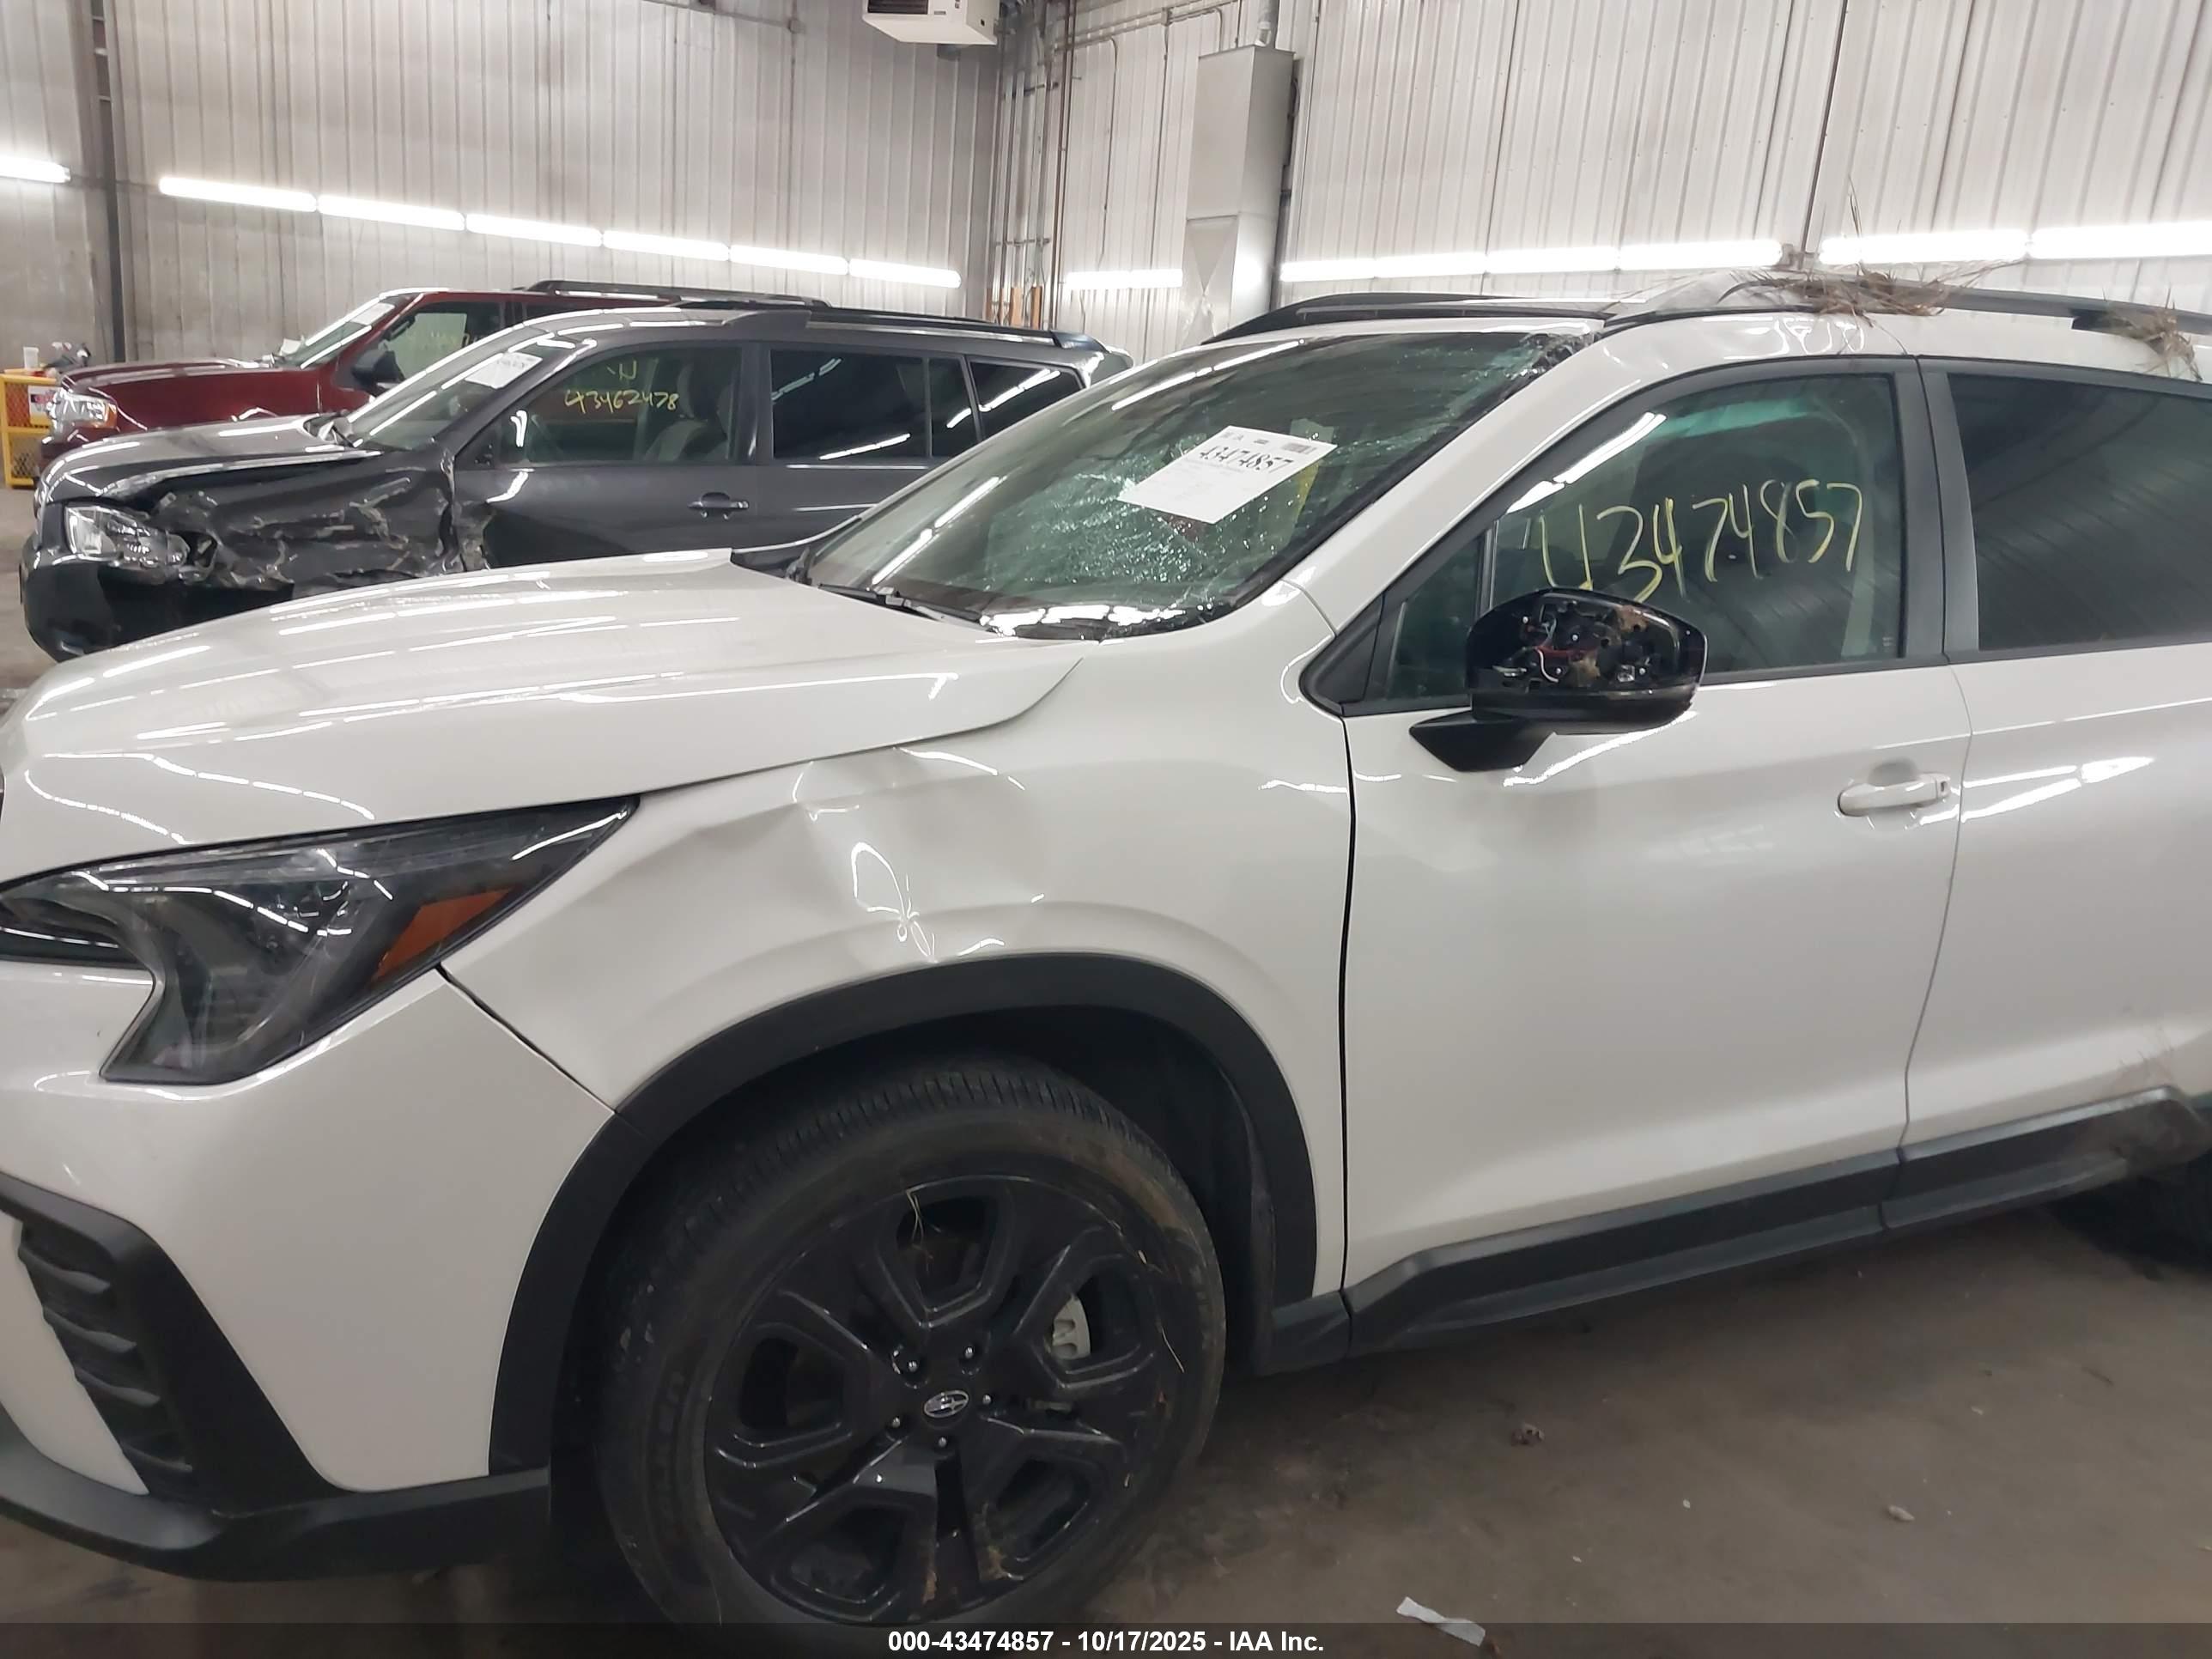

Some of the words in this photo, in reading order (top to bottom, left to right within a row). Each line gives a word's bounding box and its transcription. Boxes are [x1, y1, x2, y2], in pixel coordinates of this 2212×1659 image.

[564, 389, 679, 414] 43462478
[1200, 446, 1294, 473] 43474857
[1540, 479, 1863, 602] 43474857
